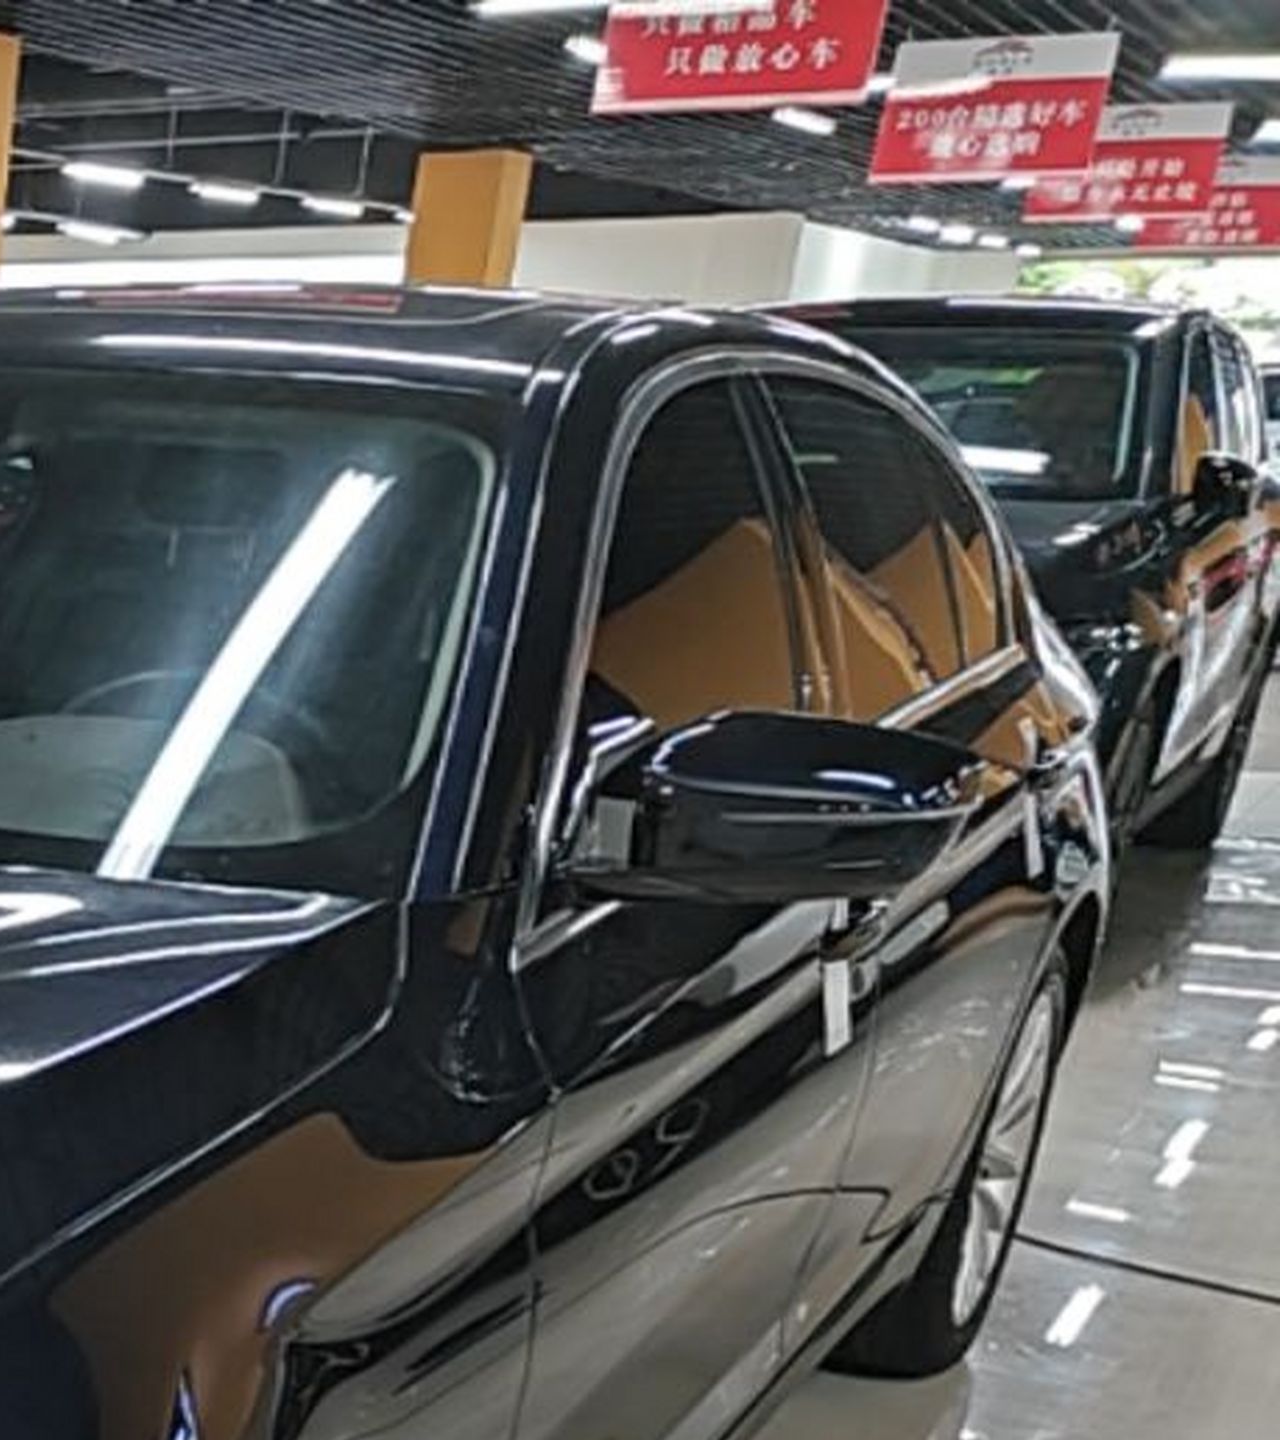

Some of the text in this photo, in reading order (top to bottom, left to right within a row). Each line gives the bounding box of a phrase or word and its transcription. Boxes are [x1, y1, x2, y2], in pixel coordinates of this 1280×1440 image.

[664, 37, 842, 75] 只做放心车
